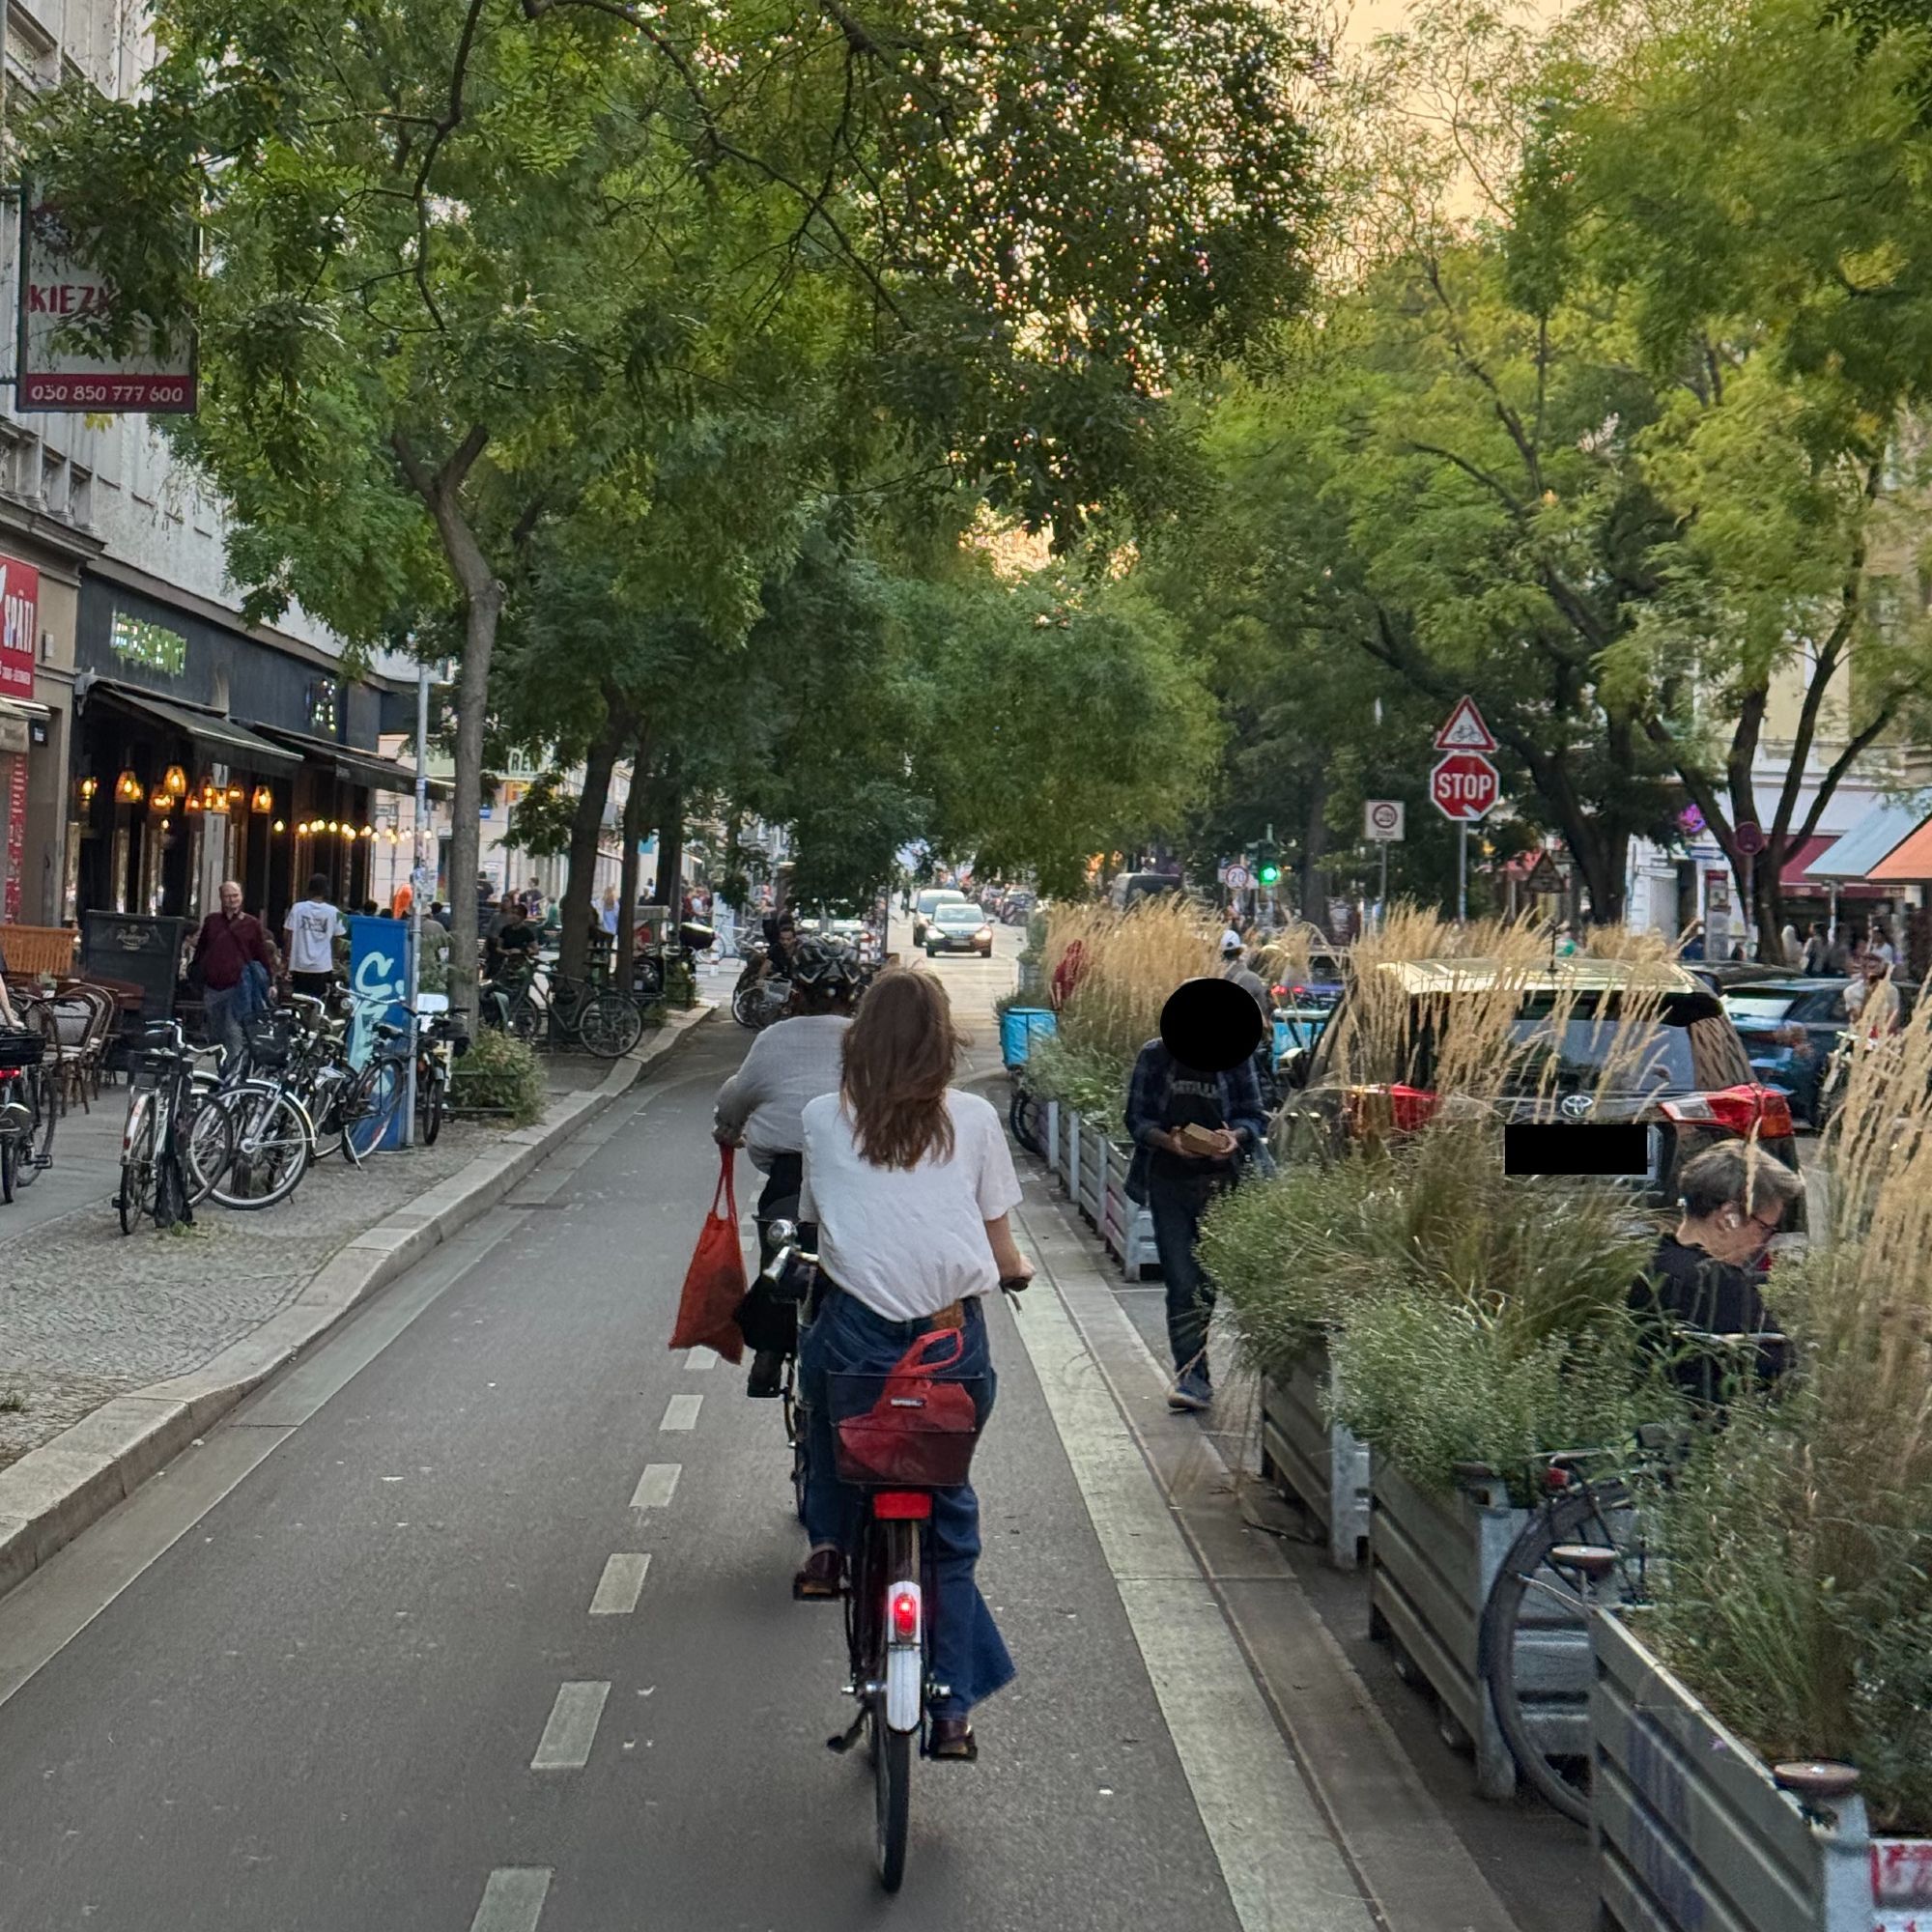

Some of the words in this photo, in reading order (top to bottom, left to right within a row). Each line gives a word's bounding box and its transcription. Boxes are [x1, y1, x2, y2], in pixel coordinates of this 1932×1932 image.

[31, 385, 68, 401] 030
[72, 386, 106, 401] 850
[111, 386, 145, 402] 777
[149, 386, 183, 402] 600
[1437, 773, 1492, 800] STOP
[1231, 871, 1245, 883] 20
